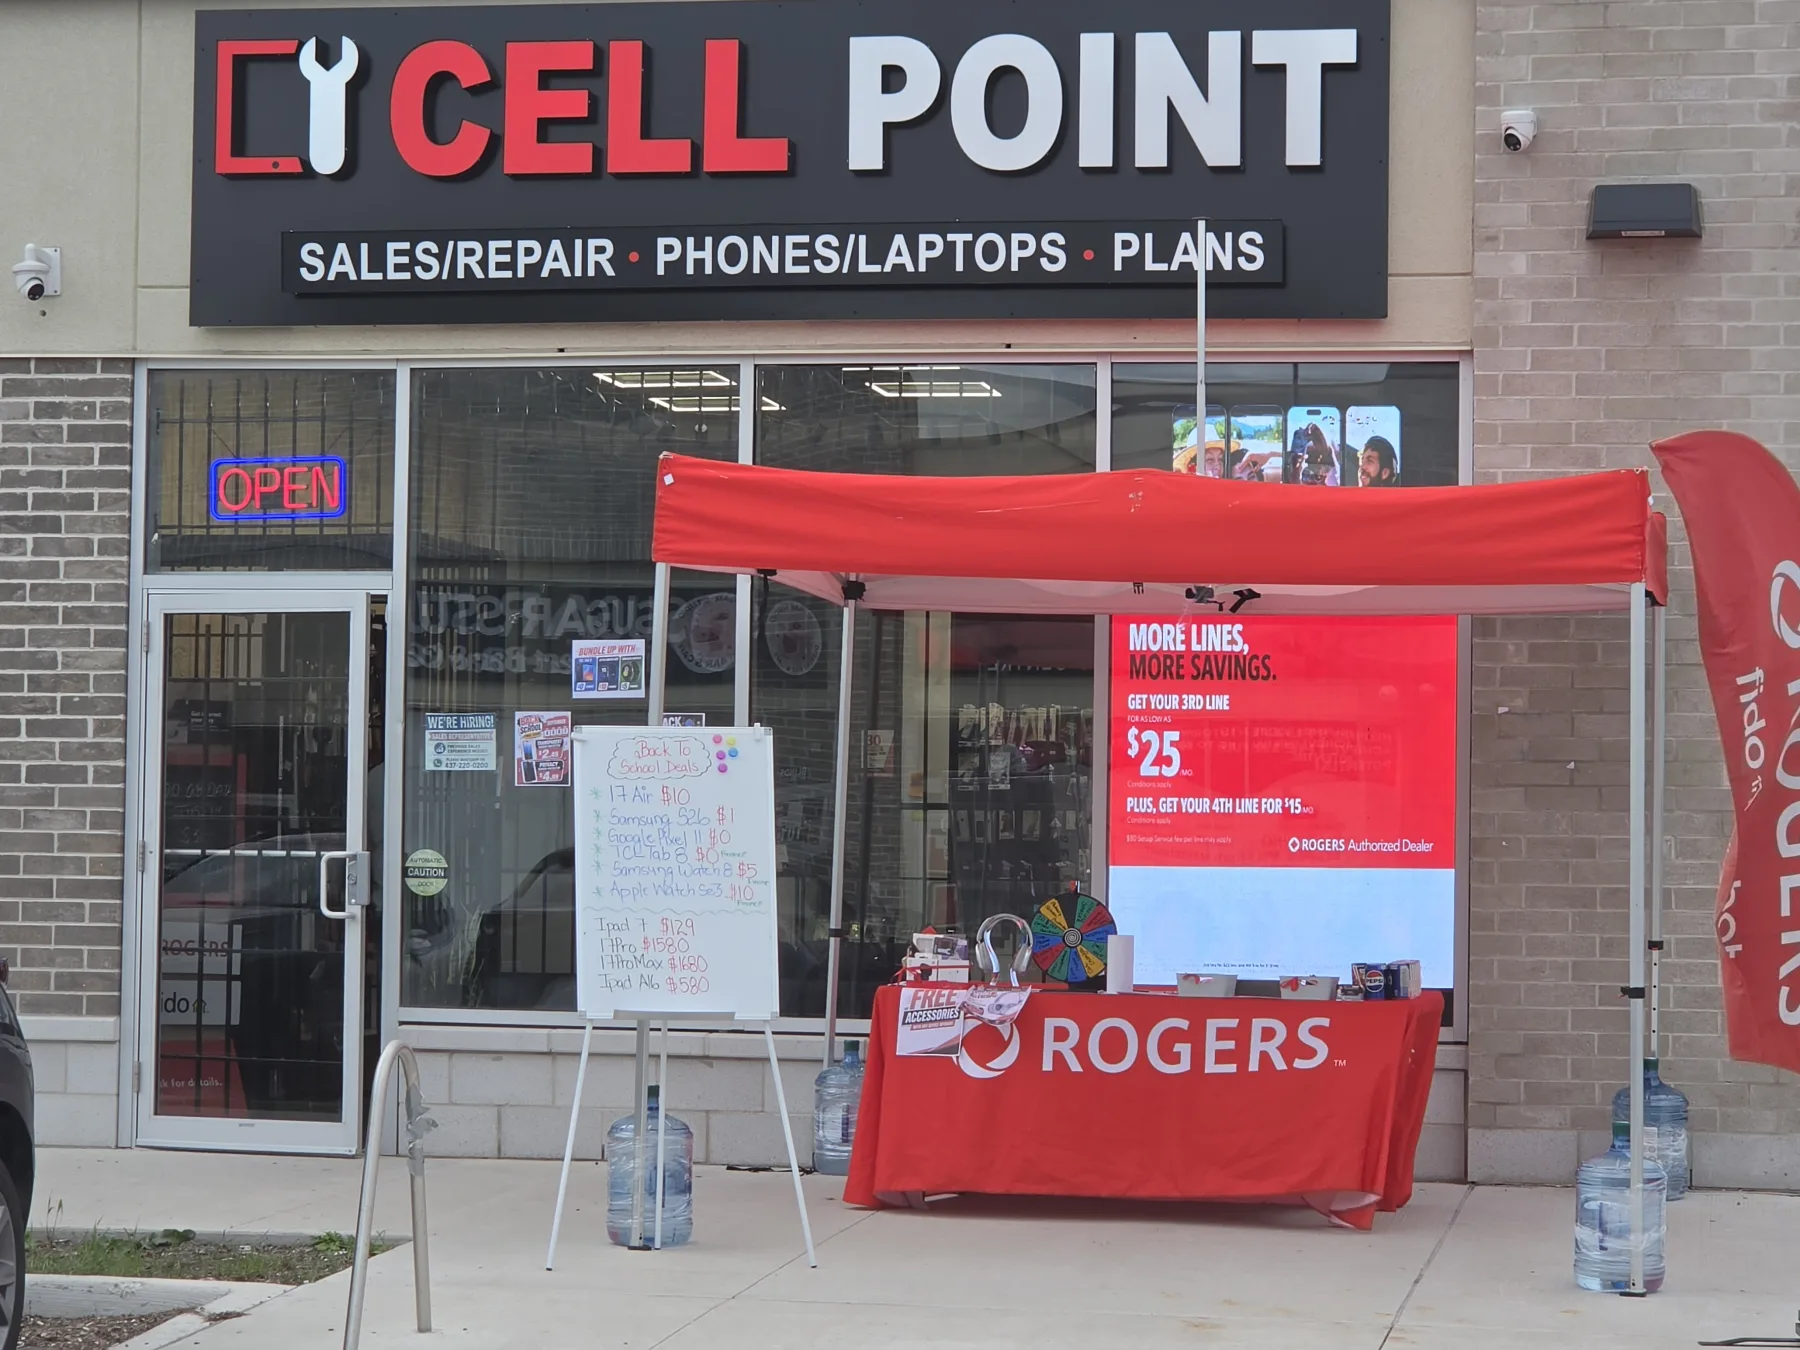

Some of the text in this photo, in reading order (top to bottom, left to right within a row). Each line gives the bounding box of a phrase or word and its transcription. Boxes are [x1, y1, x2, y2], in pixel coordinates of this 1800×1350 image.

[390, 28, 1357, 177] CELL POINT
[299, 230, 1265, 281] SALES/REPAIR PHONES/LAPTOPS PLANS
[218, 466, 340, 512] OPEN
[1129, 623, 1249, 655] MORE LINES,
[1129, 654, 1277, 682] MORE SAVINGS.
[1128, 694, 1230, 711] GET YOUR 3RD LINE
[427, 715, 494, 729] WE'RE HIRING!
[1127, 715, 1140, 723] FOR
[1149, 715, 1163, 723] LOW
[1735, 664, 1765, 770] fido
[635, 740, 691, 759] Back To
[1127, 726, 1181, 777] $25
[620, 760, 699, 774] School Deals
[609, 785, 691, 806] 17 Air $10
[1127, 797, 1157, 814] PLUS,
[1159, 797, 1178, 813] GET
[1180, 798, 1210, 813] YOUR
[1212, 798, 1233, 813] 4TH
[1236, 798, 1259, 813] LINE
[1261, 798, 1283, 814] FOR
[608, 808, 673, 828] Samsung
[608, 829, 656, 847] Google
[658, 829, 687, 846] Pixel
[1302, 838, 1434, 852] ROGERS Authorized Dealer
[647, 844, 671, 860] Tab
[695, 846, 719, 865] $0
[407, 867, 445, 877] CAUTION
[611, 862, 674, 882] Samsung
[677, 862, 721, 878] Watch
[736, 861, 758, 879] $5
[609, 880, 648, 903] Apple
[652, 881, 696, 898] Watch
[660, 916, 695, 937] $129
[641, 935, 690, 955] $1580
[667, 954, 708, 974] $1680
[665, 975, 710, 995] $580
[909, 989, 958, 1010] FREE
[904, 1007, 960, 1024] ACCESSORIES
[1041, 1016, 1332, 1075] ROGERS
